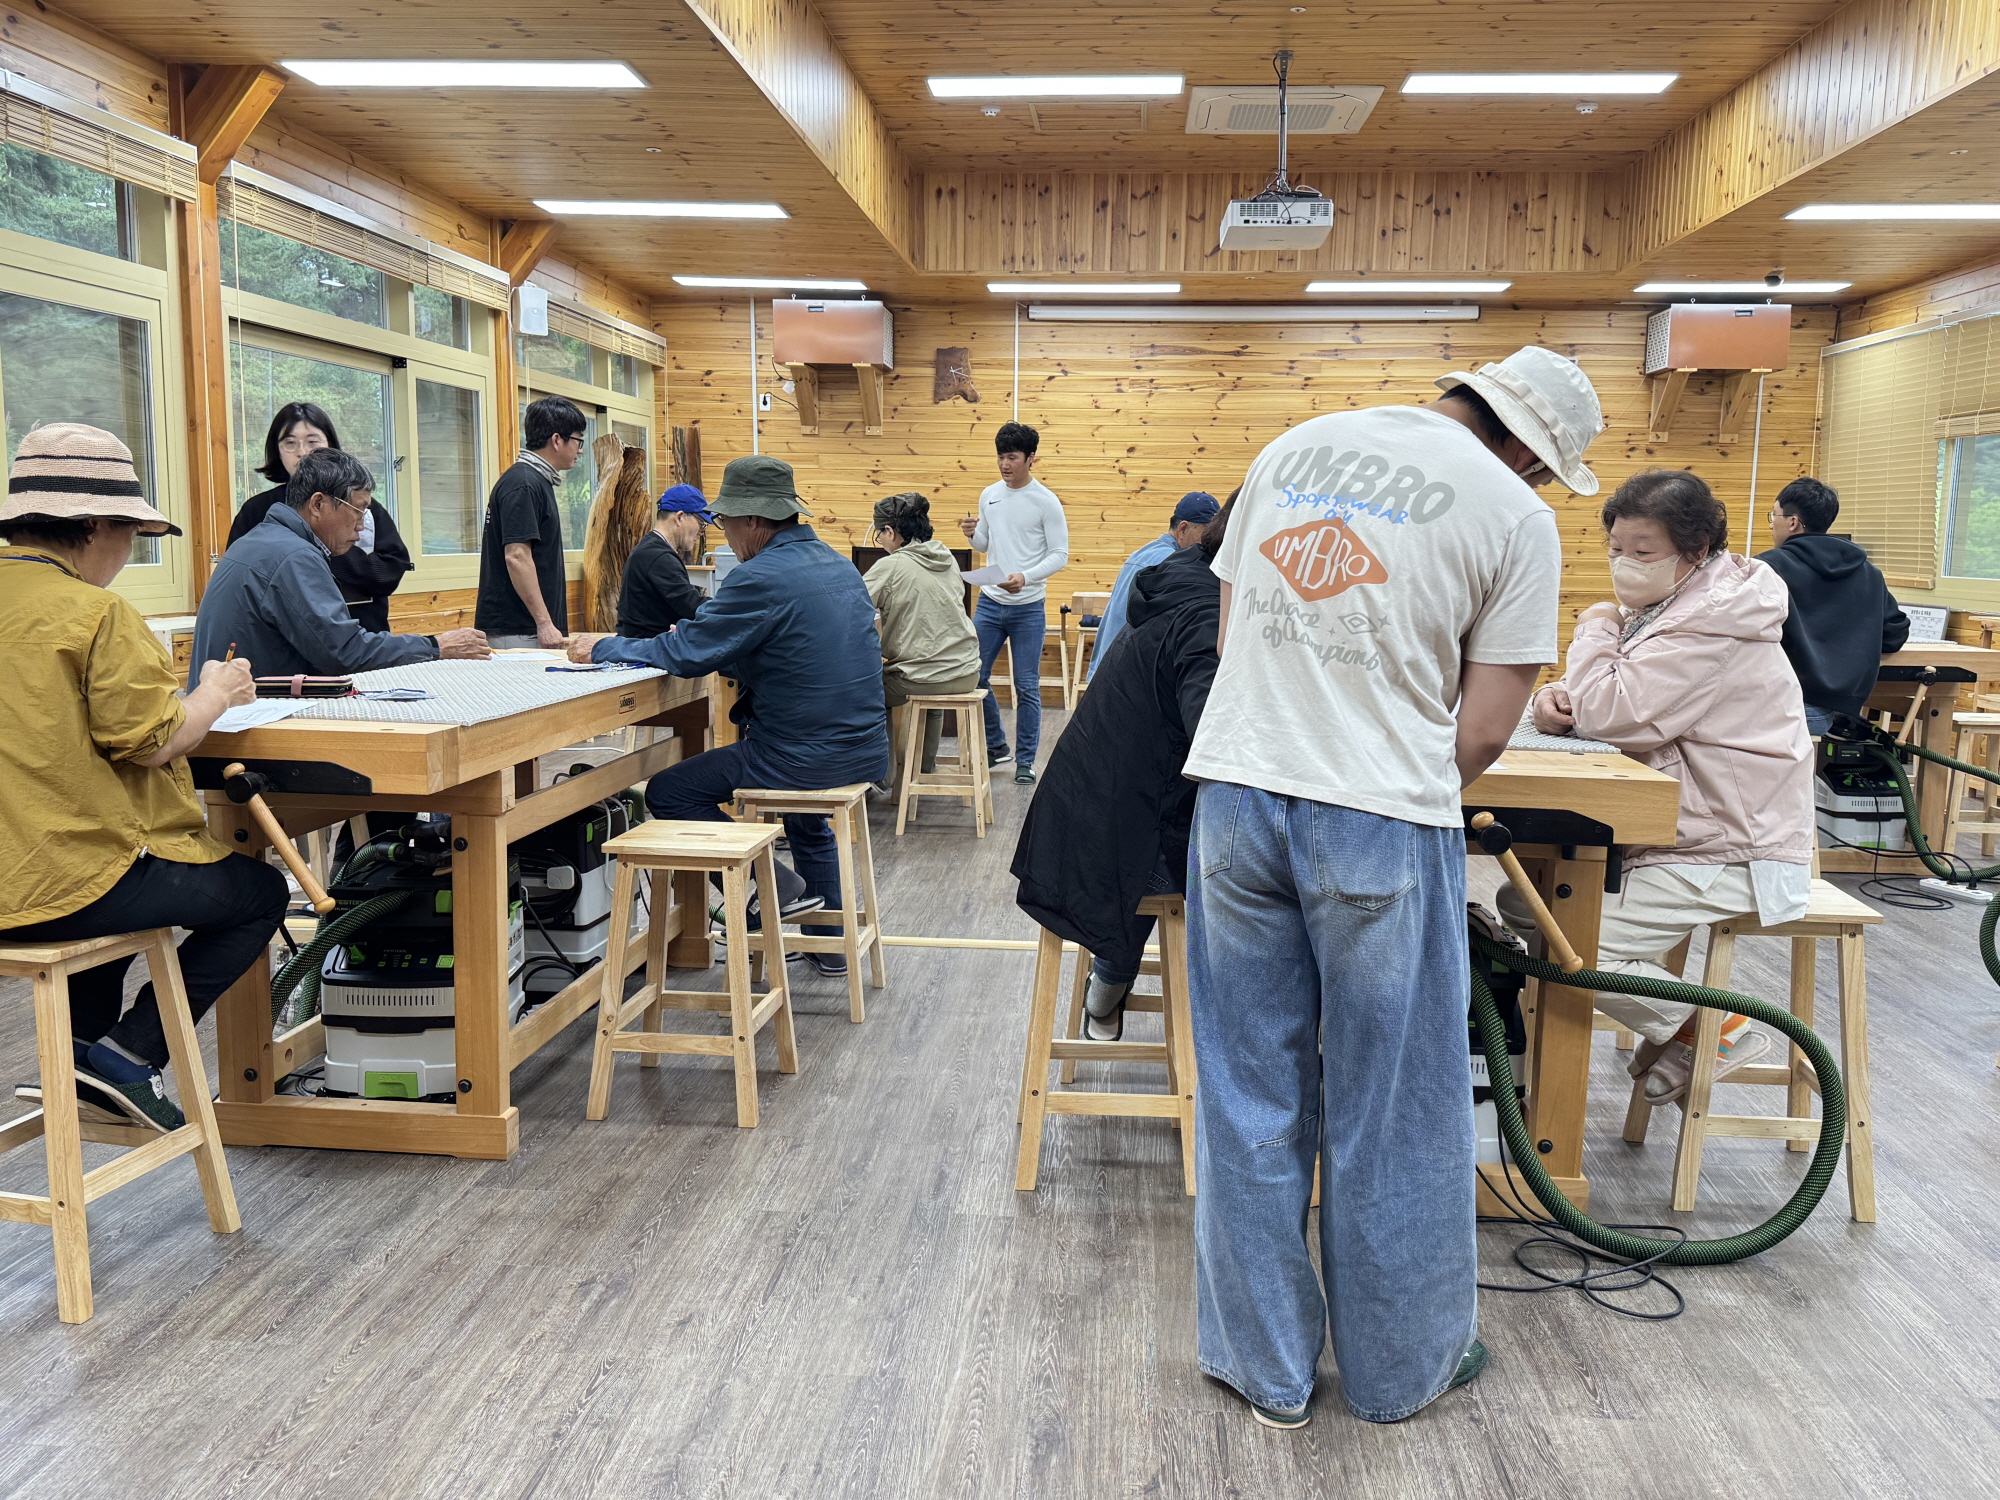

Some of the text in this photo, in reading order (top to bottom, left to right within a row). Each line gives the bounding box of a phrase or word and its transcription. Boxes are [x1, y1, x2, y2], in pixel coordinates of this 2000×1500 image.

[1272, 445, 1456, 525] UMBRO
[1274, 526, 1370, 590] UMBRO
[1244, 587, 1320, 628] The Choice
[1262, 616, 1379, 671] of Champions
